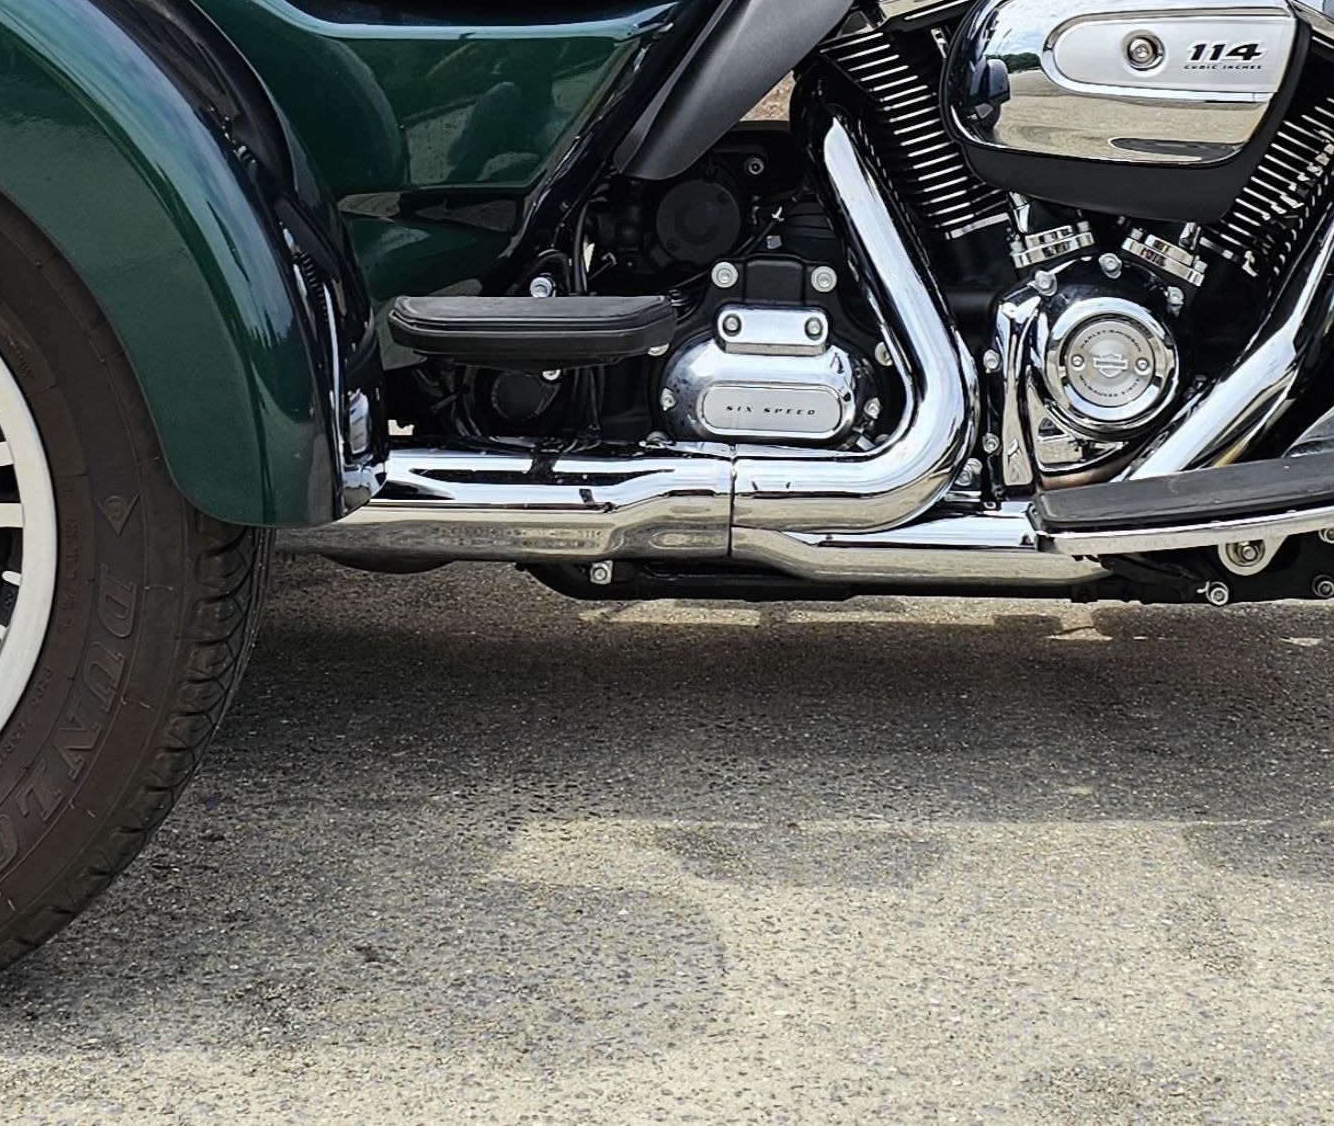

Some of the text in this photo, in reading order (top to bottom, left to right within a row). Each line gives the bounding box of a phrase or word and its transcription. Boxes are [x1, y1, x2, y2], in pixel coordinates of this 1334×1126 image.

[1189, 42, 1264, 62] 114
[1080, 329, 1142, 352] HARLEY-DAVIDSON
[725, 404, 817, 416] SIX SPEED
